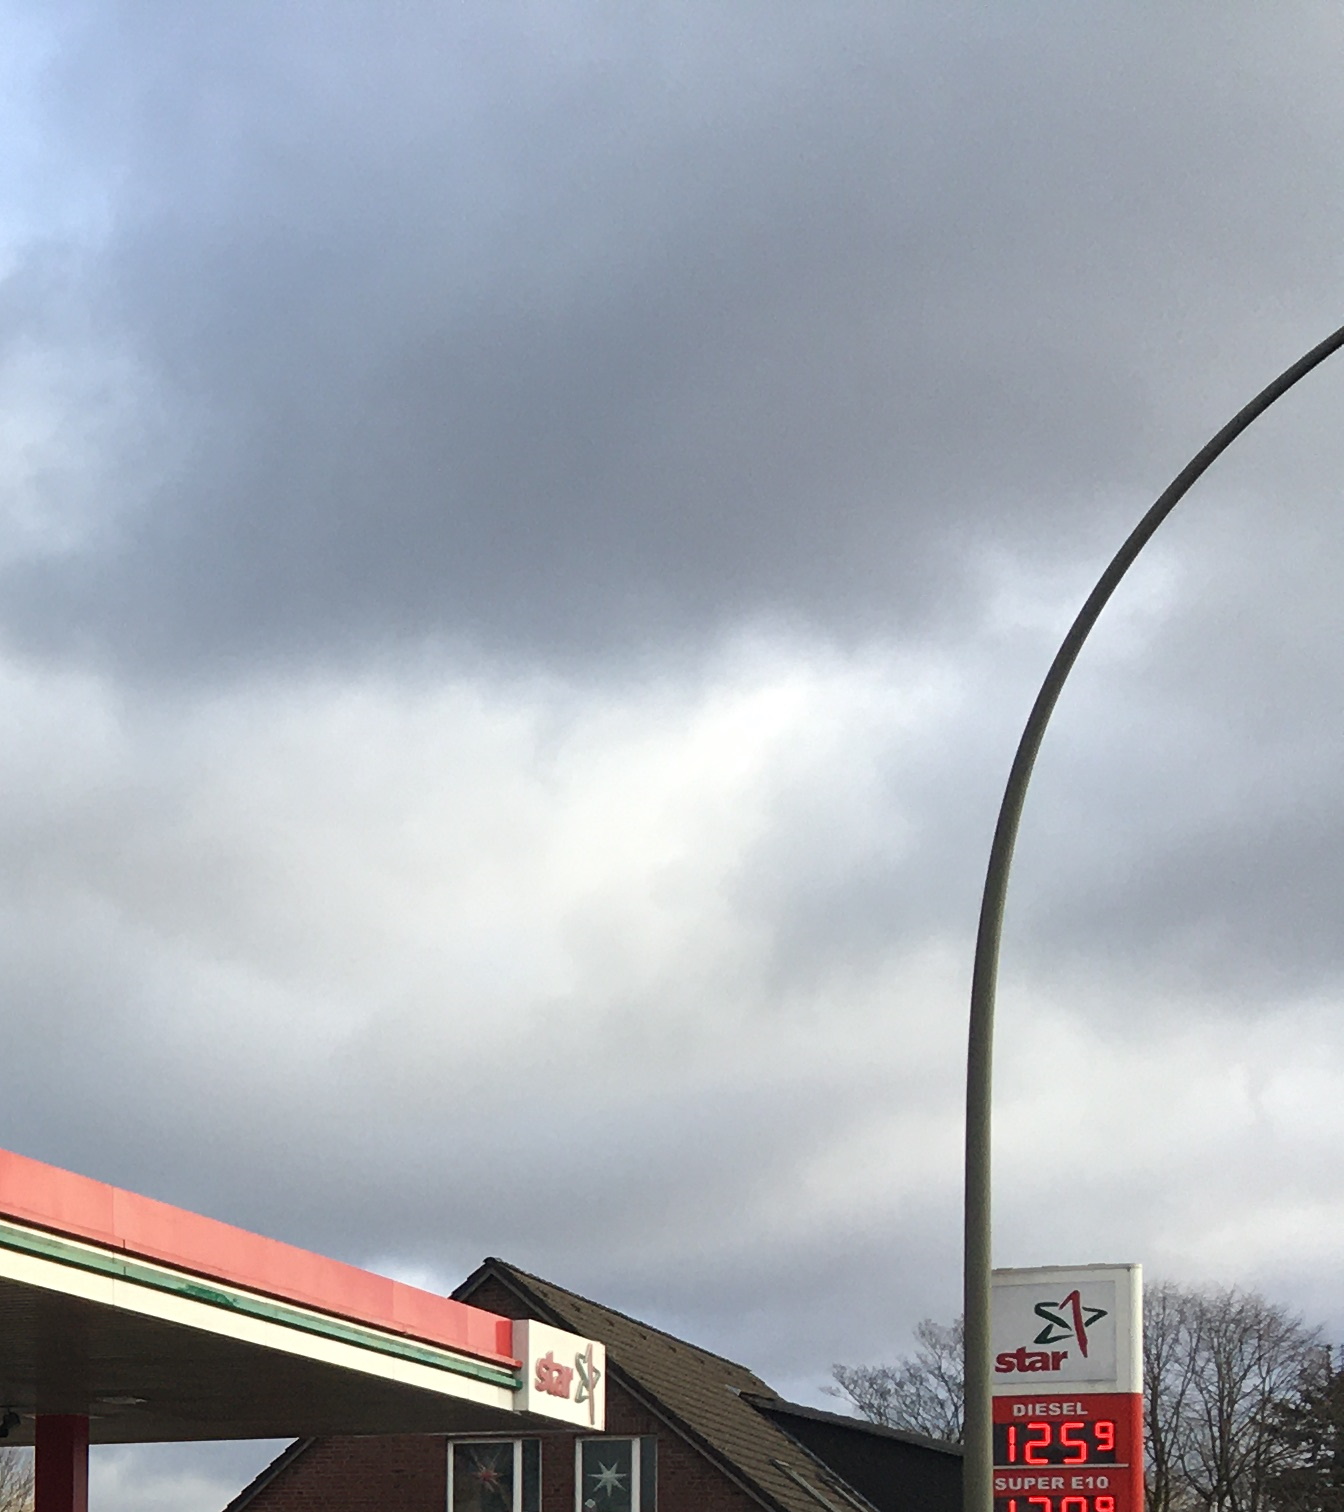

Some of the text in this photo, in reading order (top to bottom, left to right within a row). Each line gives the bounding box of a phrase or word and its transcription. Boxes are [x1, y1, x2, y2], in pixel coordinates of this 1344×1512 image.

[995, 1346, 1068, 1373] star
[535, 1351, 573, 1399] star
[1013, 1402, 1088, 1416] DIESEL
[995, 1476, 1109, 1490] SUPER E10
